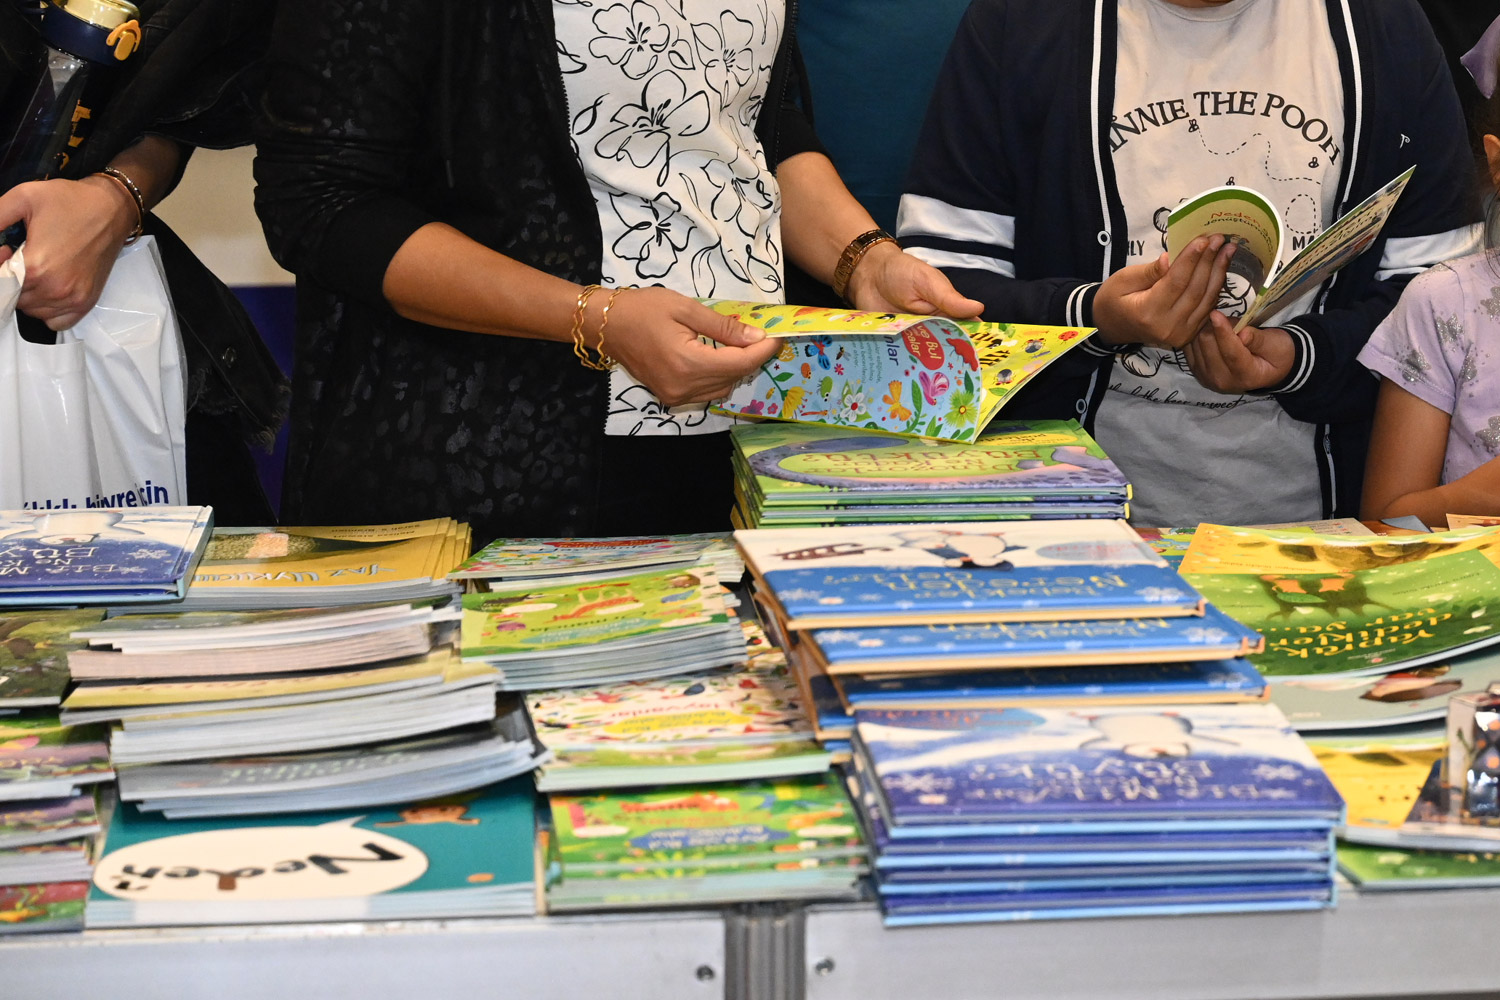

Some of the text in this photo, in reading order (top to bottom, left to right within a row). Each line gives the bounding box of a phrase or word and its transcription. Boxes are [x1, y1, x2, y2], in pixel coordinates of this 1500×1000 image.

[1108, 97, 1190, 153] INNIE
[1193, 90, 1258, 117] THE
[926, 341, 942, 360] Bul
[804, 463, 1014, 474] Dinozorlar
[1273, 629, 1436, 659] Yaprak
